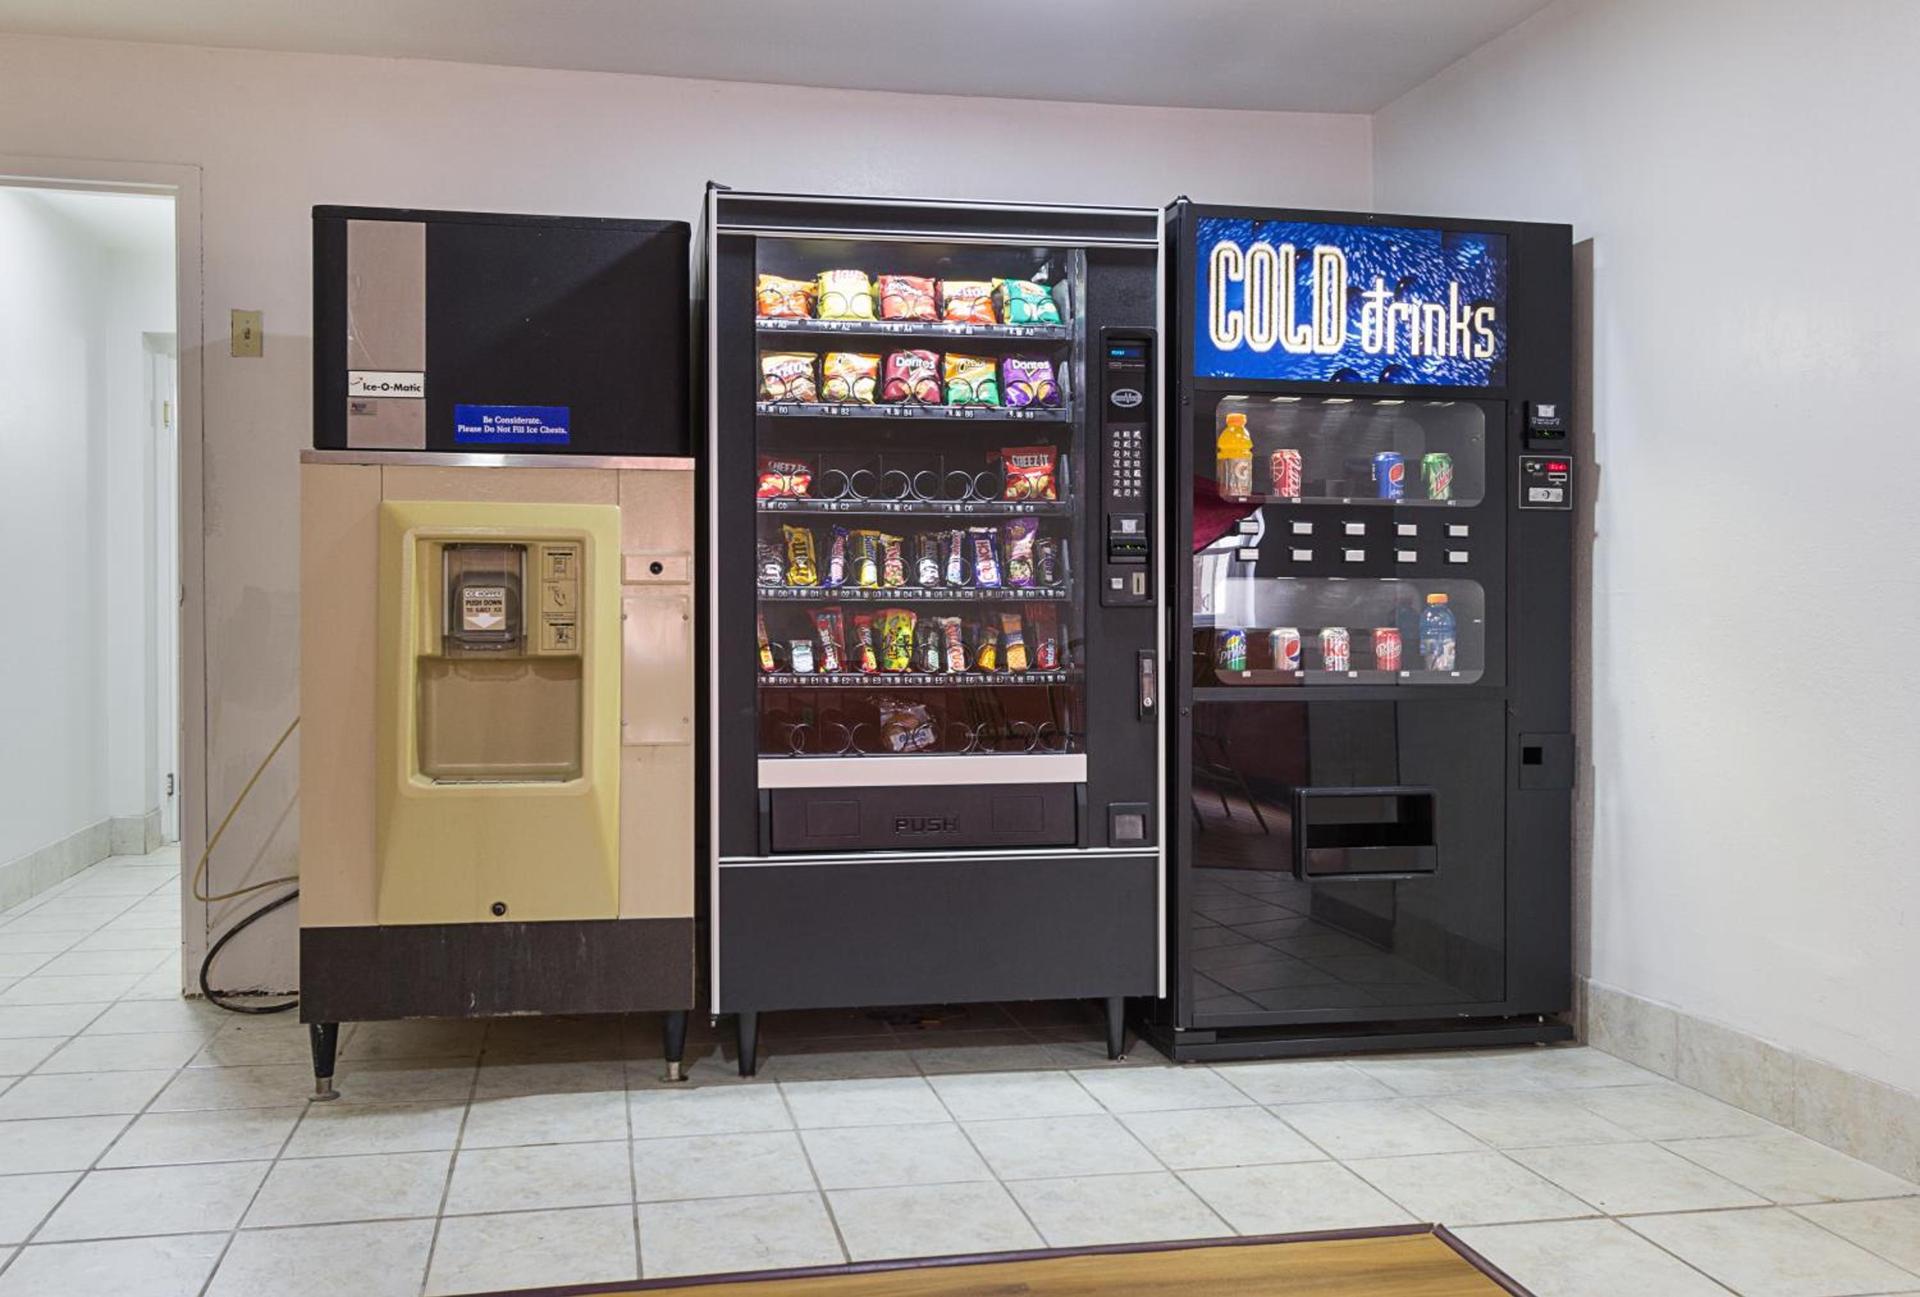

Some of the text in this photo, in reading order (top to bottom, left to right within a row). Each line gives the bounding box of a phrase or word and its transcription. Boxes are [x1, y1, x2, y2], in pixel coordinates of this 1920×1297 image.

[1209, 240, 1495, 359] COLD drinks
[896, 356, 935, 370] Doritos
[1012, 359, 1050, 370] Doritos
[363, 382, 422, 392] Ice-O-Matic
[483, 415, 543, 425] Be Considerate.
[457, 424, 568, 434] Please Do Not Fill Ice Chests.
[895, 818, 957, 832] PUSH
